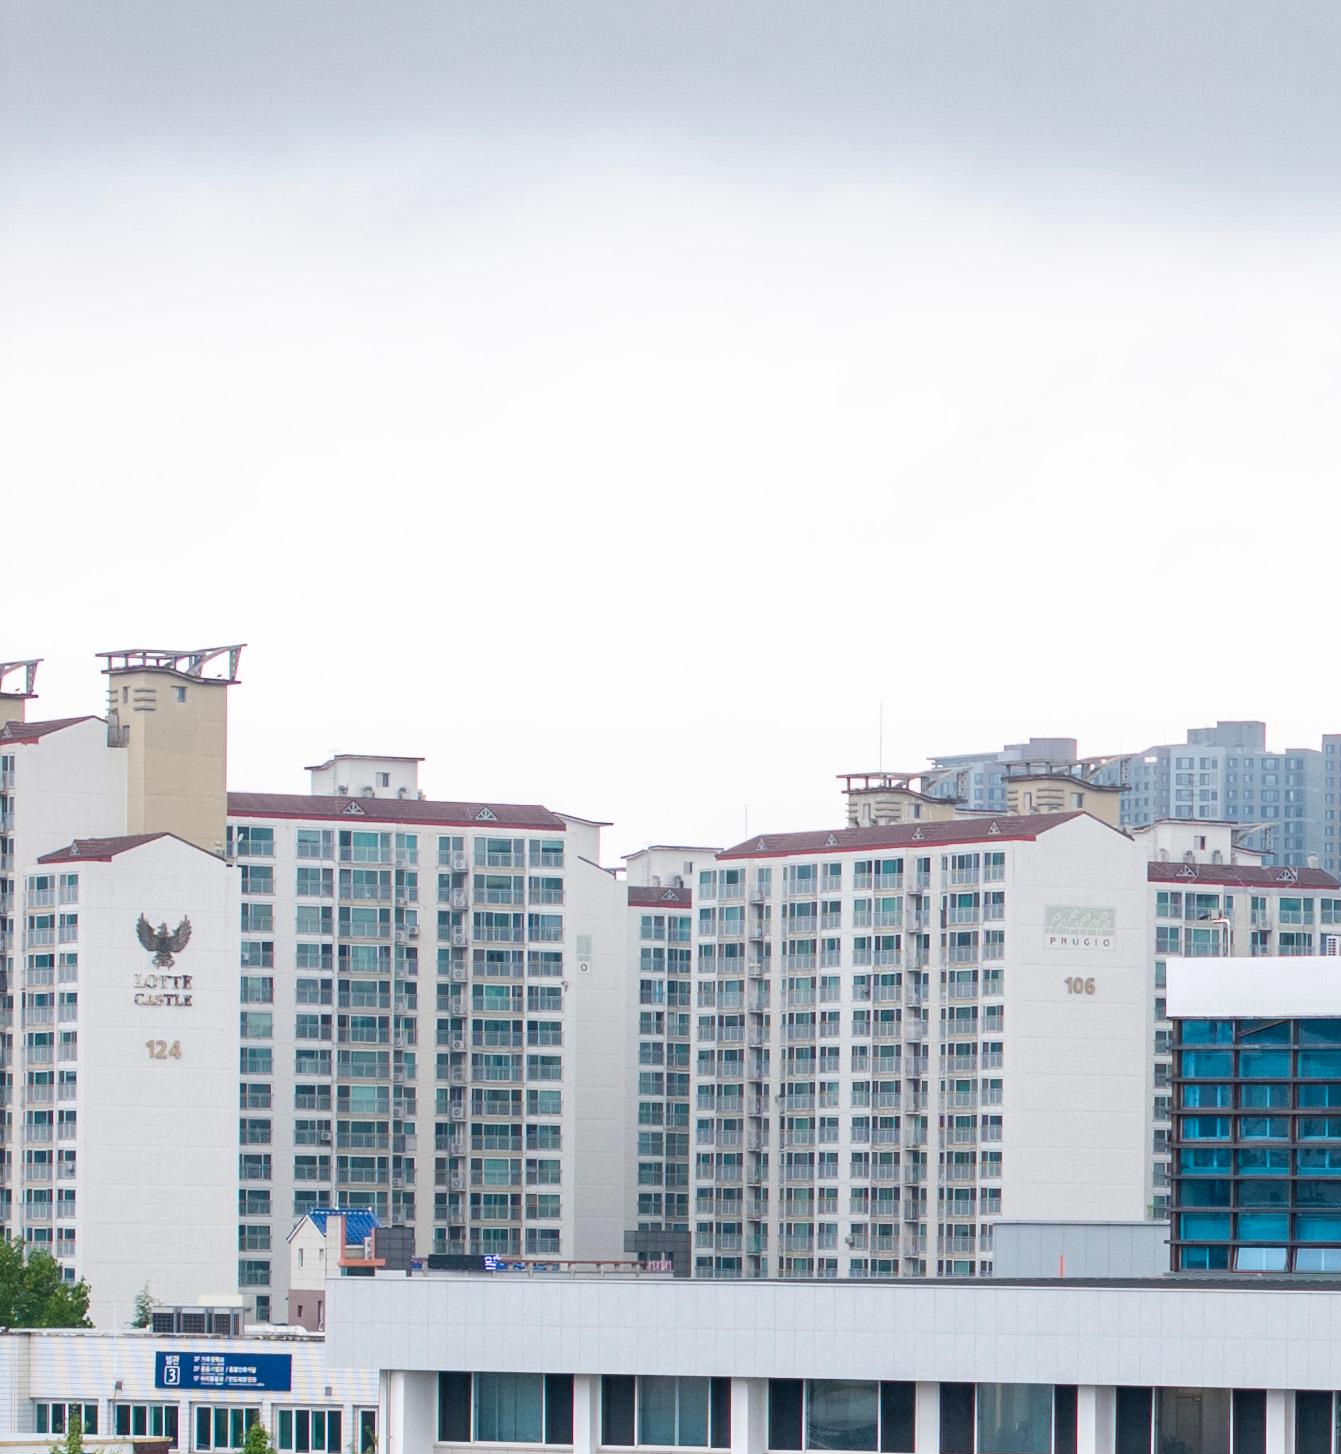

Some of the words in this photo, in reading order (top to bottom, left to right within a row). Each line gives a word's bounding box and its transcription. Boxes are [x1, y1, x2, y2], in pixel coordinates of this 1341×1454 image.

[1049, 936, 1110, 947] PRUGIO
[134, 973, 193, 990] LOTTE
[1064, 976, 1096, 995] 106
[134, 993, 193, 1007] CASTLE
[145, 1039, 182, 1060] 124
